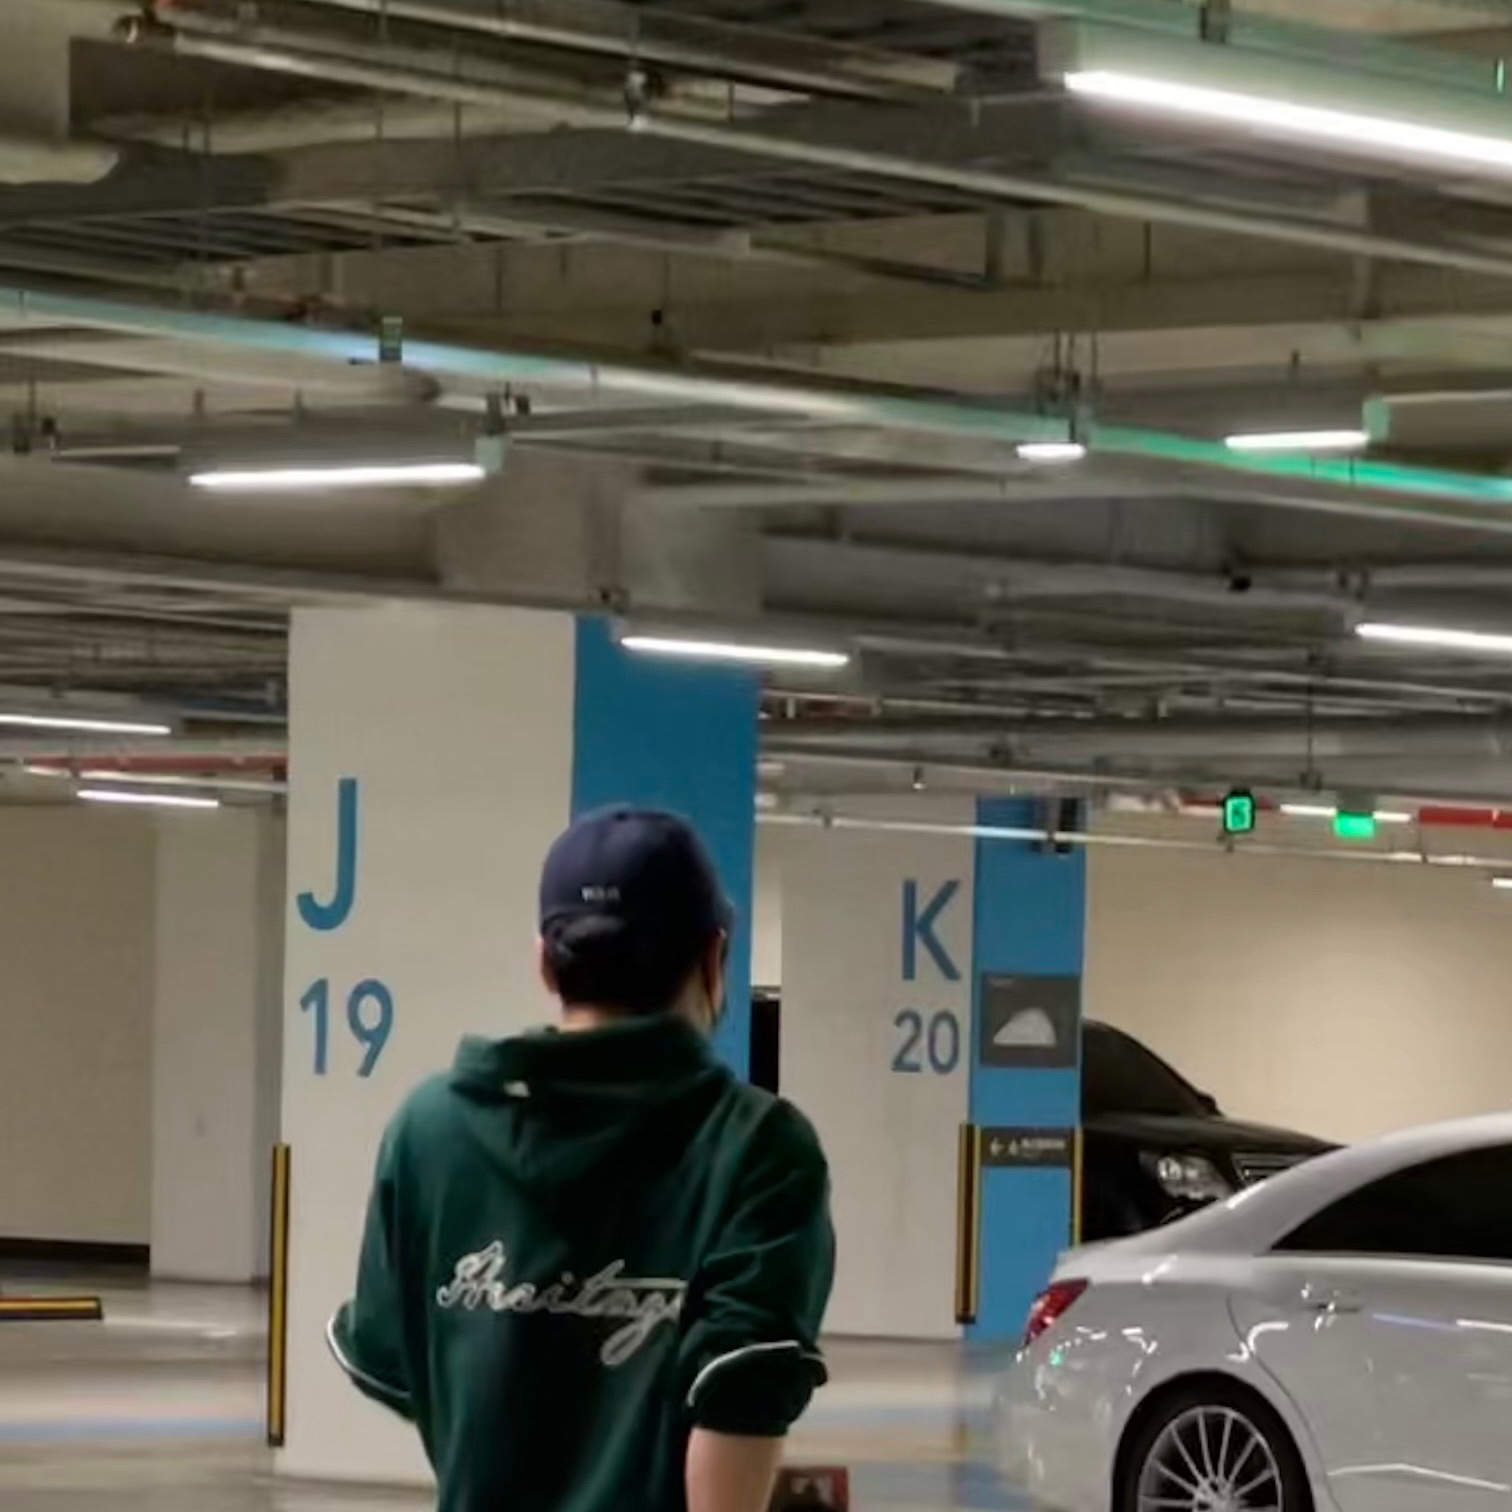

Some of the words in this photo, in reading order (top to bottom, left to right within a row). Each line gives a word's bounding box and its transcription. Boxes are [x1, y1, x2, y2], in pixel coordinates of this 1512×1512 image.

[297, 778, 359, 931] J
[901, 879, 961, 981] K
[299, 979, 394, 1077] 19
[892, 1010, 960, 1074] 20
